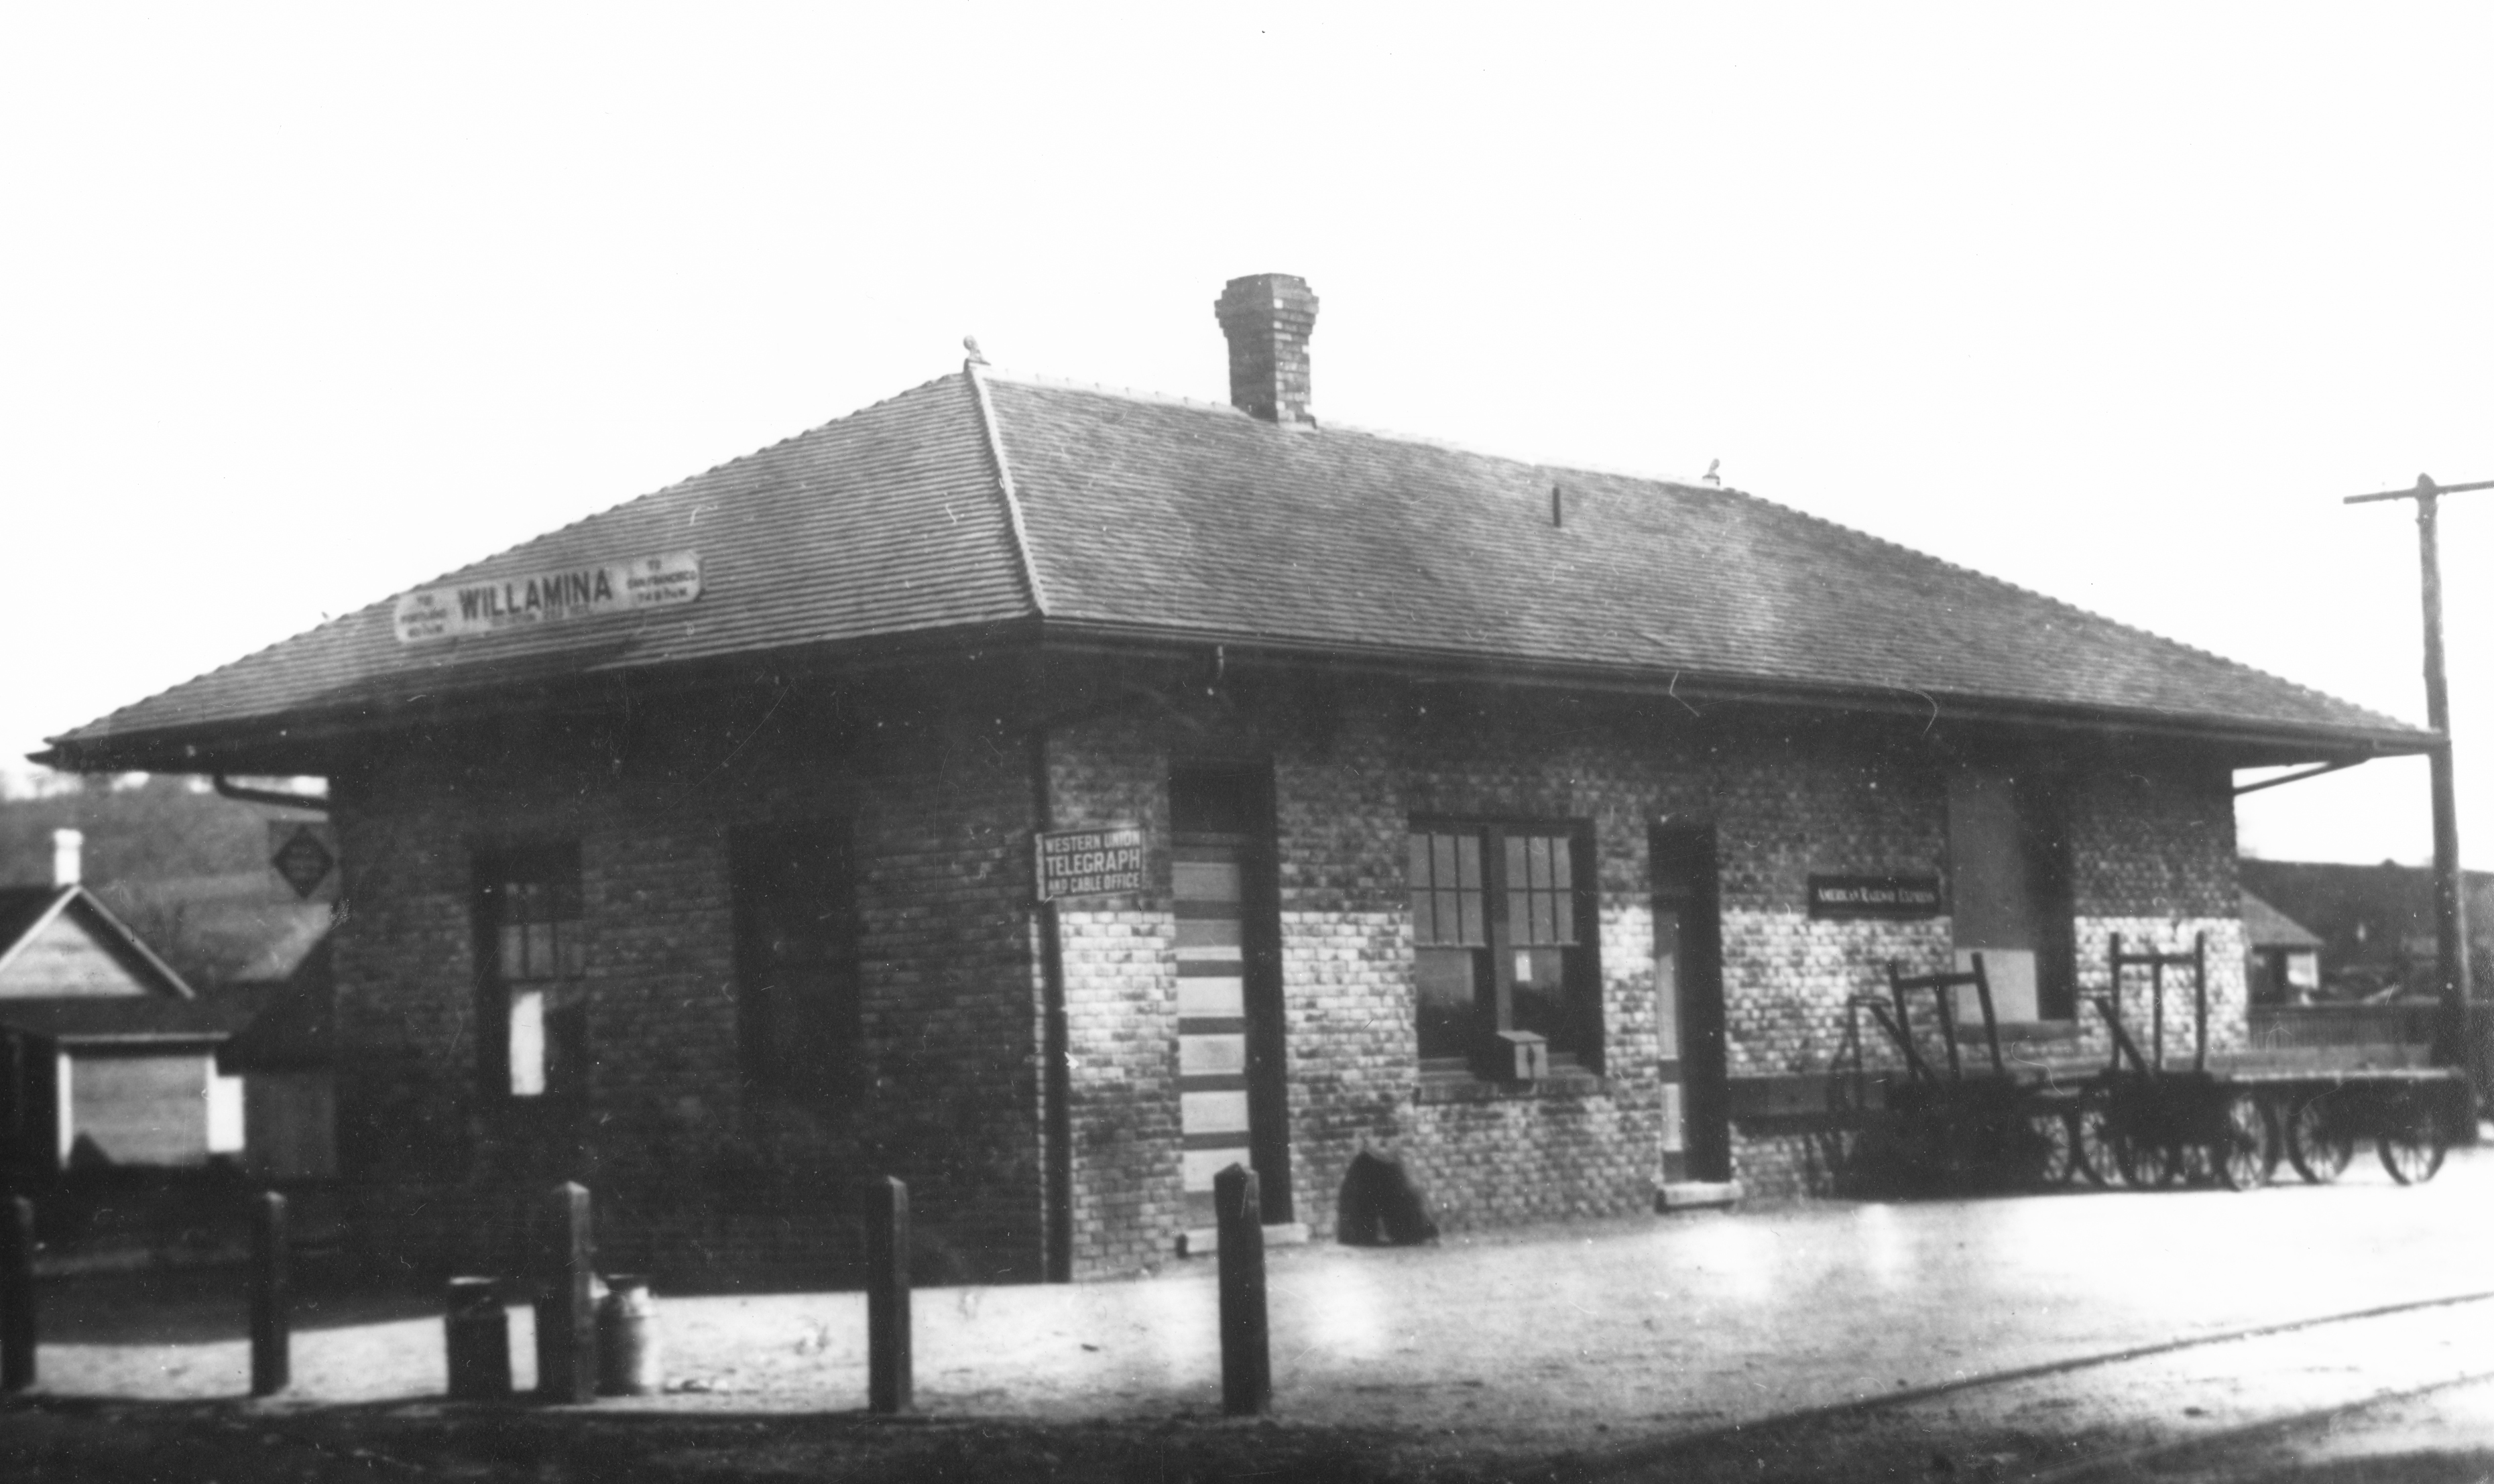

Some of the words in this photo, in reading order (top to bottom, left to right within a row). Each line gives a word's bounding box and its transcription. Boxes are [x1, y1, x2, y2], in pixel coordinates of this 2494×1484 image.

[458, 569, 613, 620] WILLAMINA
[1045, 834, 1101, 853] WESTERN
[1104, 830, 1140, 849] UNION
[1046, 848, 1140, 877] TELEGRAPH
[1048, 878, 1069, 891] AND
[1070, 875, 1102, 892] CABLE
[1104, 872, 1140, 889] OFFICE
